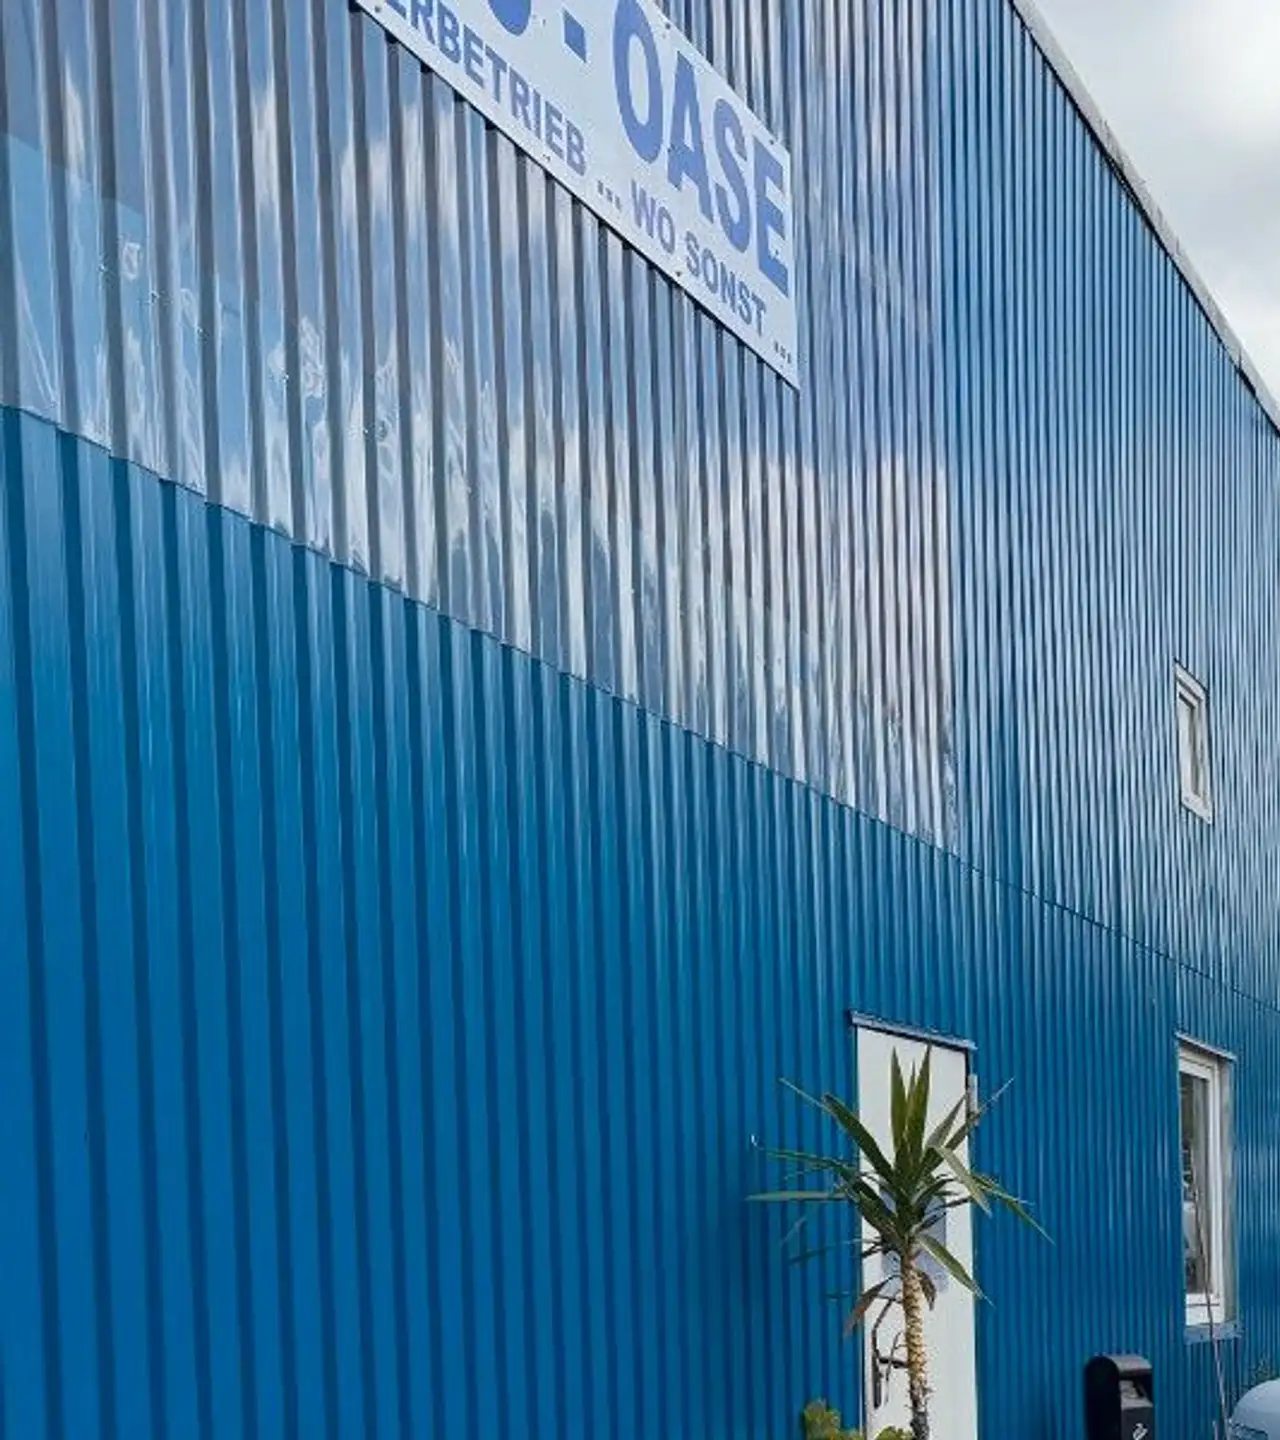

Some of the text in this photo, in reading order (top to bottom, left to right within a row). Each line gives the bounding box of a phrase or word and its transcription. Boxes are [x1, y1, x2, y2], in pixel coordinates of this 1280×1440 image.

[612, 0, 789, 299] OASE
[630, 179, 676, 254] WO
[684, 230, 767, 337] SONST
